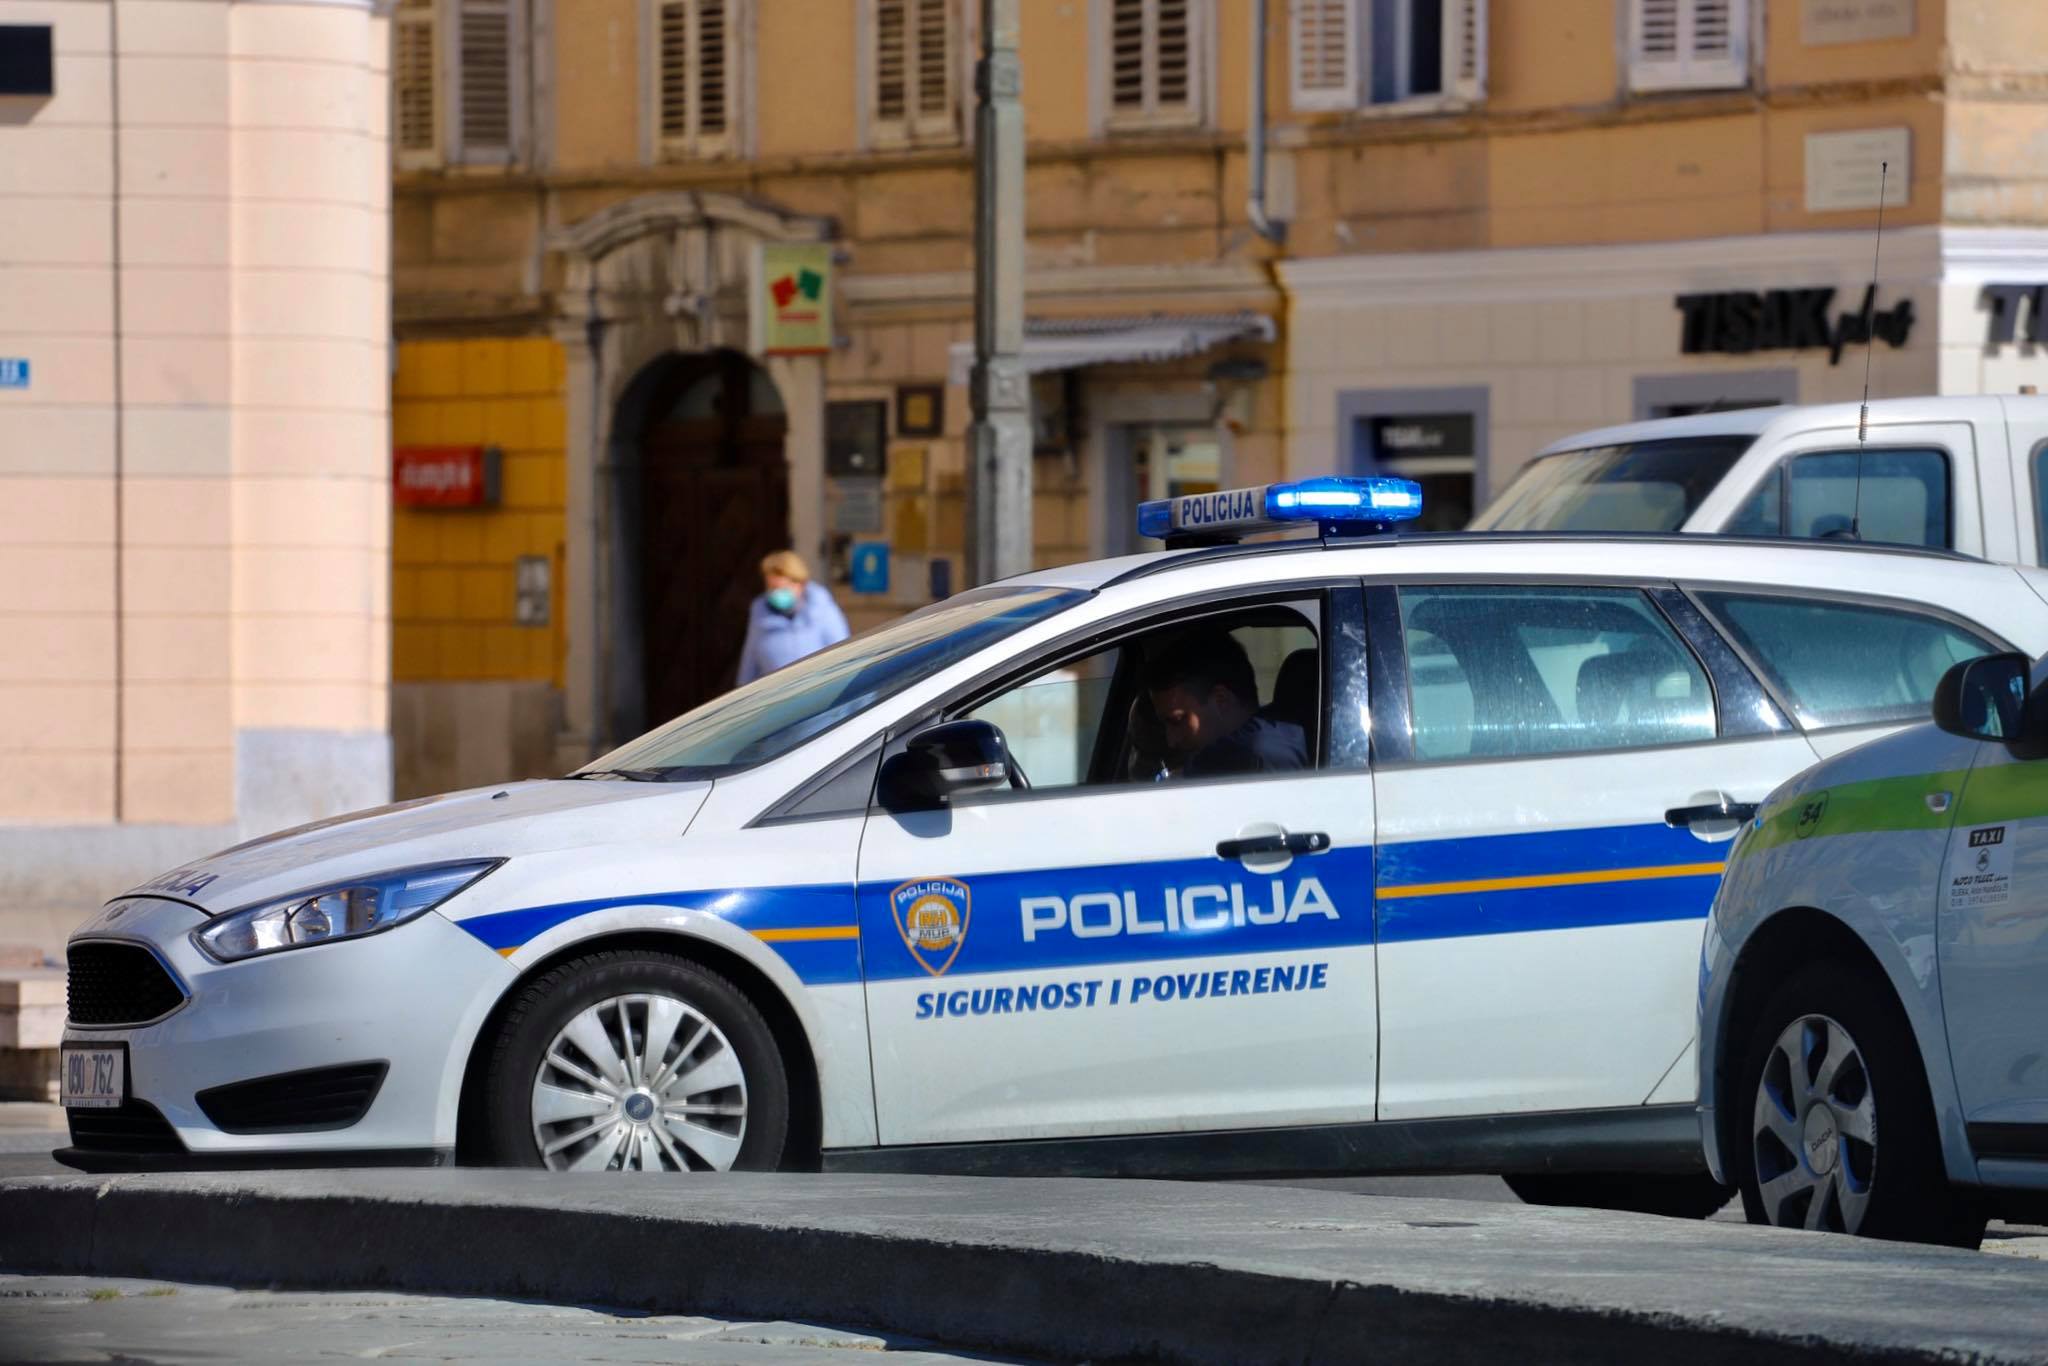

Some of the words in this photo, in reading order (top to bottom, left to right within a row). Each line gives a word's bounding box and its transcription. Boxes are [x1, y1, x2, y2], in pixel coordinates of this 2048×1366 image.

[1674, 287, 1836, 354] TISAK
[1183, 490, 1254, 525] POLICIJA
[1800, 801, 1823, 825] 54
[1972, 829, 2003, 845] TAXI
[897, 882, 965, 904] POLICIJA
[1020, 877, 1340, 942] POLICIJA
[915, 980, 1101, 1019] SIGURNOST
[1109, 979, 1122, 1006] I
[1130, 963, 1328, 1004] POVJERENJE
[92, 1054, 114, 1094] 762
